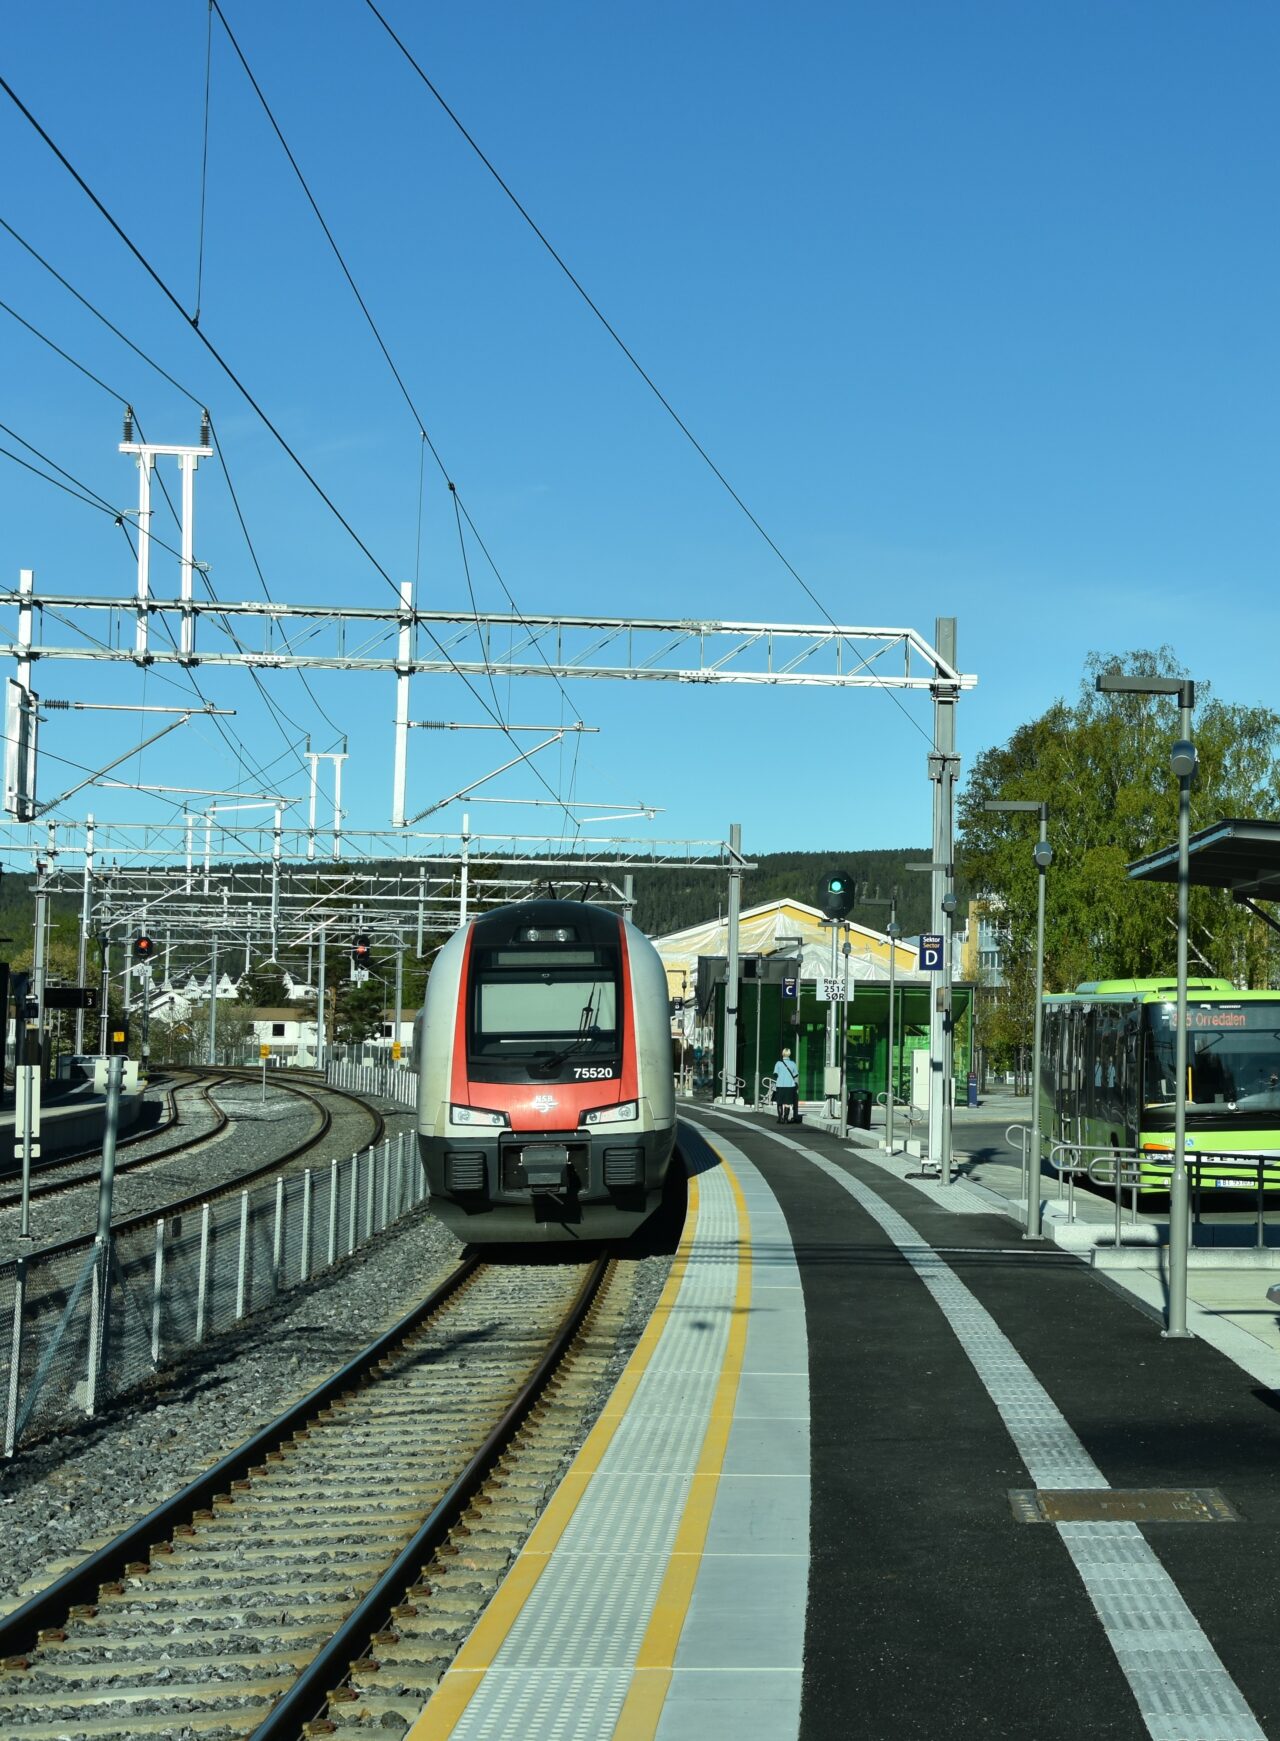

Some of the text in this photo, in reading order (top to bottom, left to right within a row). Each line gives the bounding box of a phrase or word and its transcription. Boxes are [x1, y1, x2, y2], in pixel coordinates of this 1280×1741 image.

[925, 949, 938, 966] D
[785, 985, 793, 995] C
[825, 992, 846, 1001] SØR
[1195, 1011, 1246, 1026] Orredalen
[573, 1067, 613, 1079] 75520
